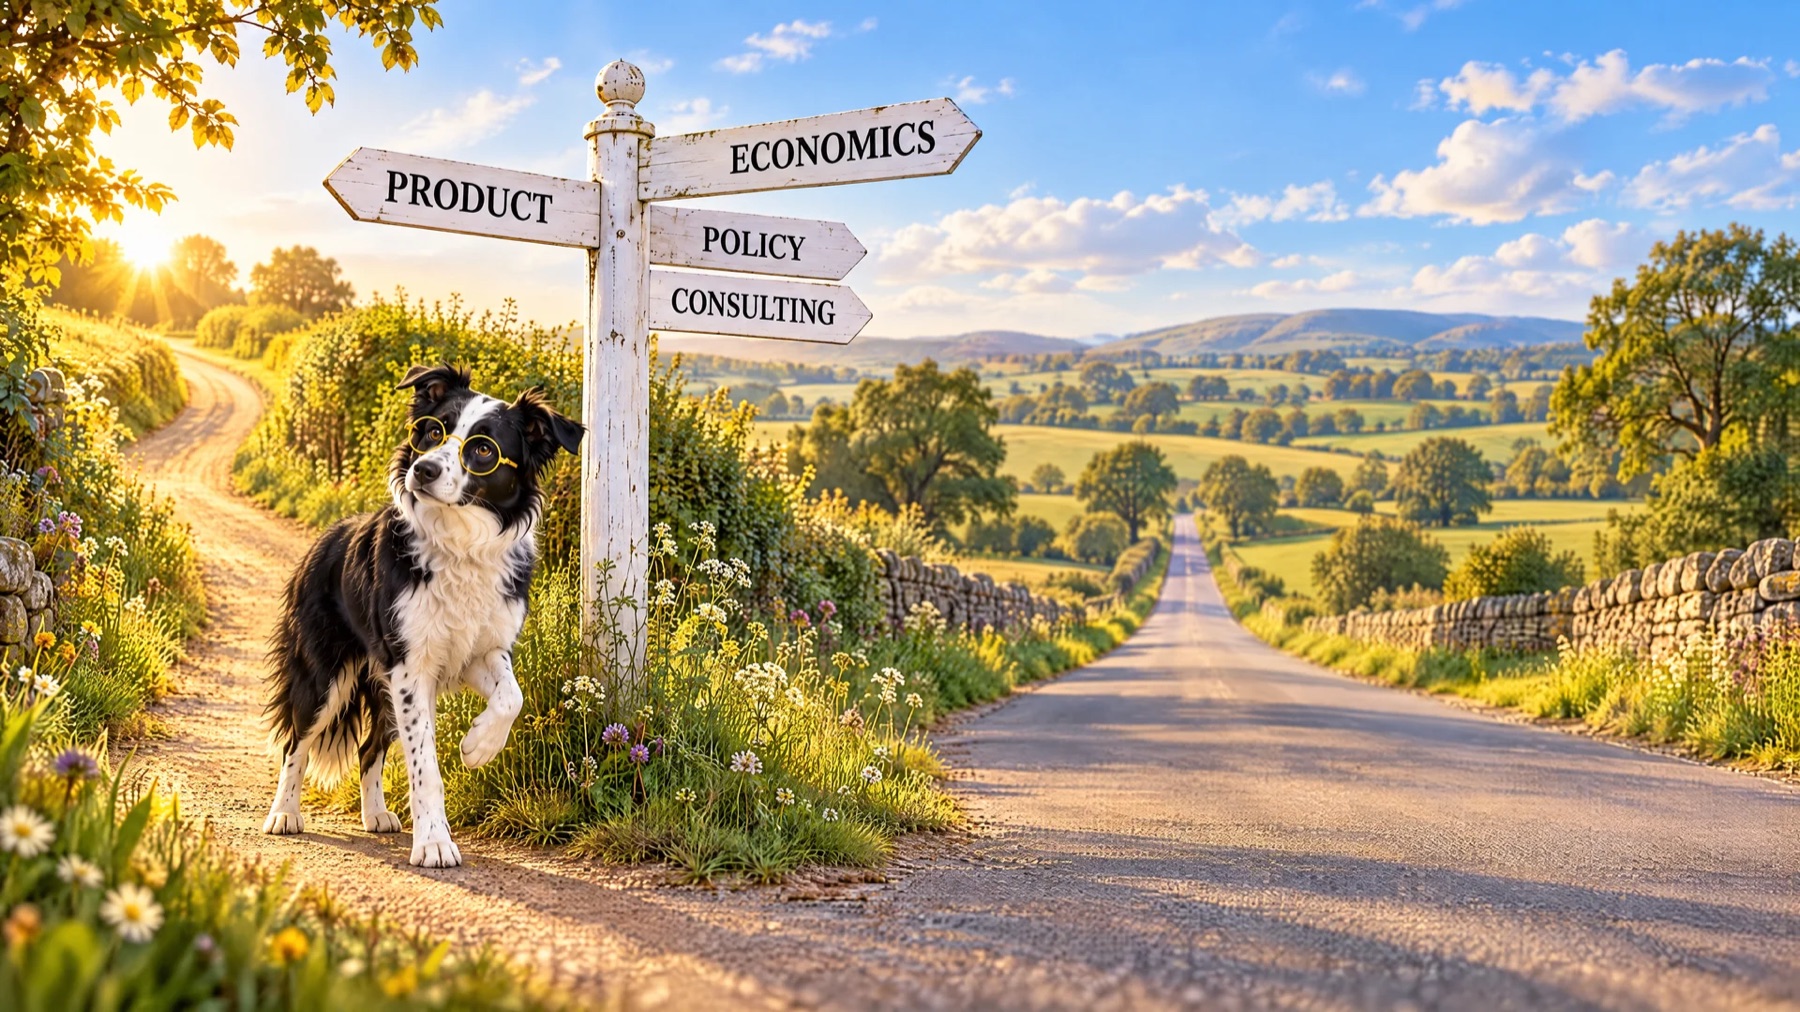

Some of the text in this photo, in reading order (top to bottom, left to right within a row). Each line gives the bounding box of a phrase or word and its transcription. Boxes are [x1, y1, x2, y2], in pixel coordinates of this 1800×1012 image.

[730, 120, 936, 175] ECONOMICS
[385, 170, 553, 224] PRODUCT
[702, 226, 806, 261] POLICY
[671, 287, 836, 326] CONSULTING
